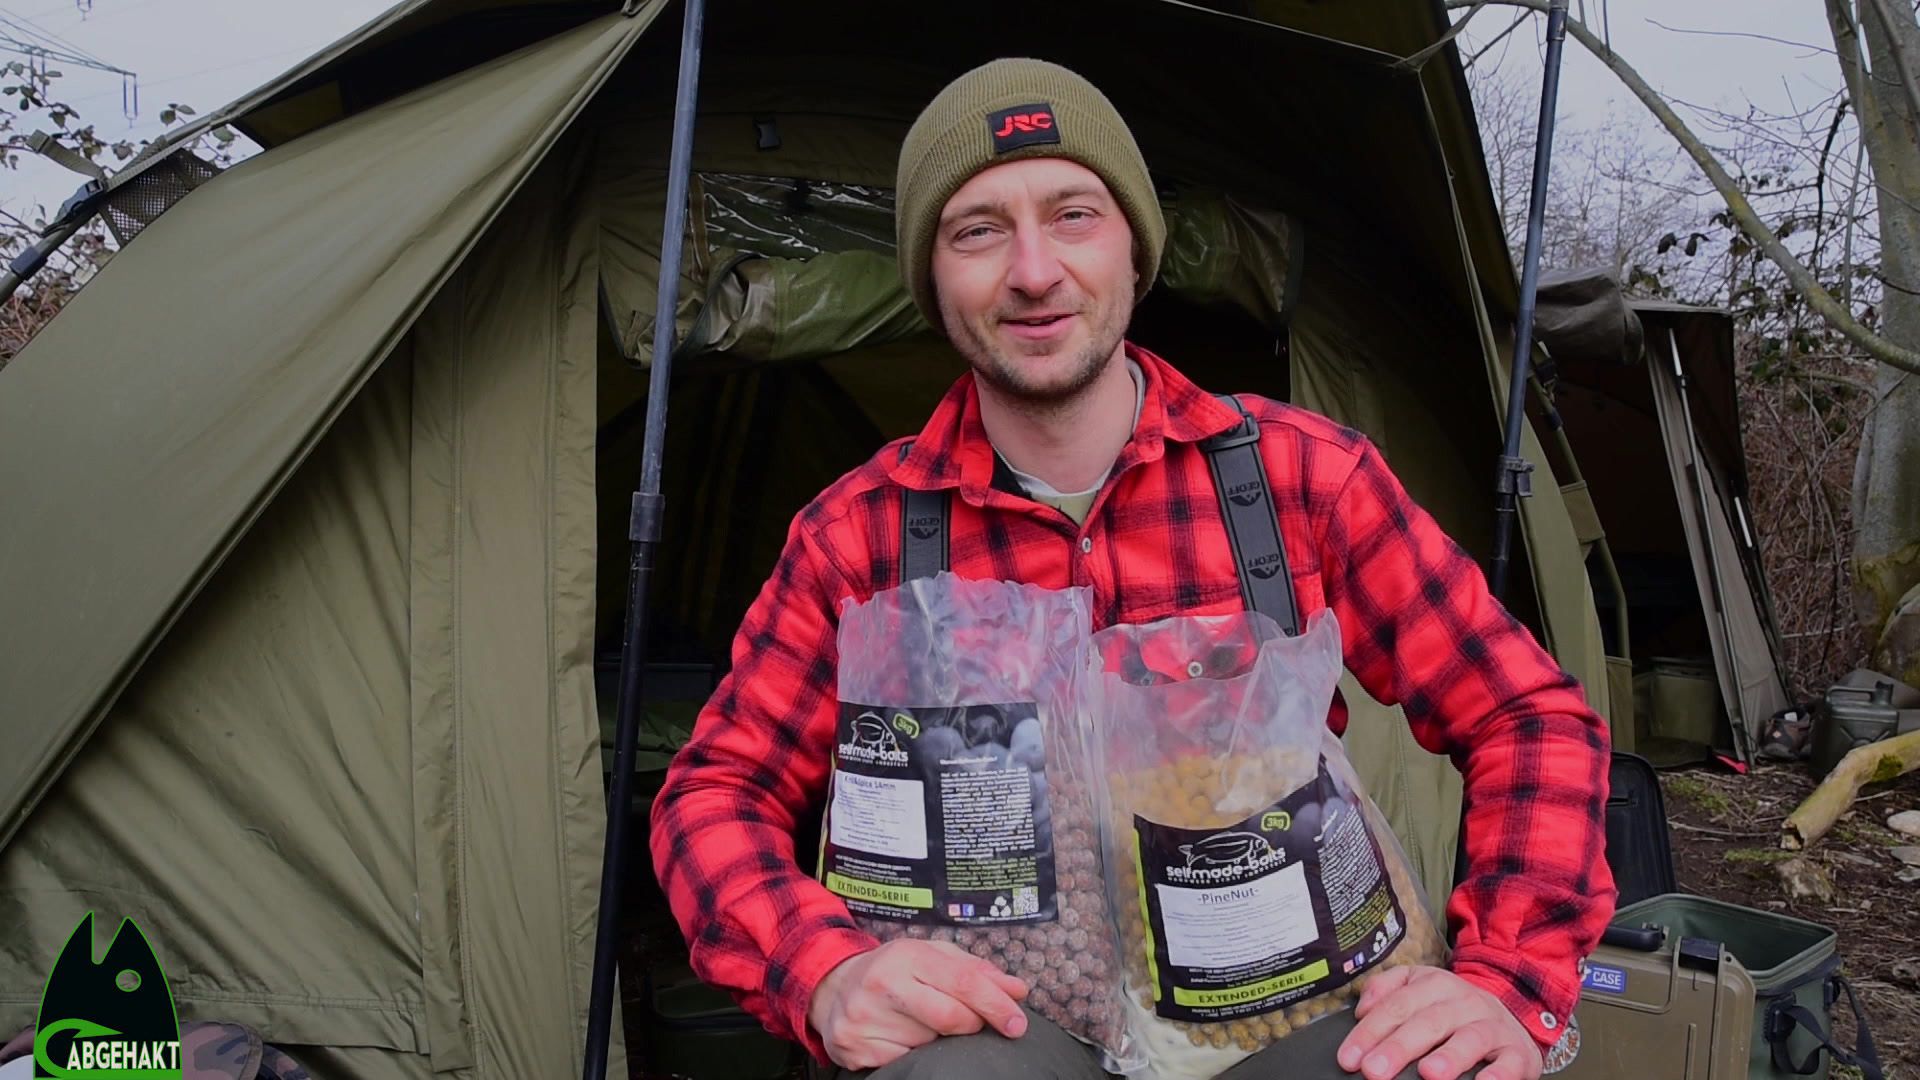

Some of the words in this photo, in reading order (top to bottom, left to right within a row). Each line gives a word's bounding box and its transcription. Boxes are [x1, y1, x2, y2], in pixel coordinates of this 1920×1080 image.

[995, 112, 1052, 137] JRC
[1227, 481, 1260, 496] GEOFF
[1248, 553, 1279, 568] GEOFF
[1166, 847, 1286, 880] selfmade-baits
[837, 880, 910, 902] EXTENDED-SERIE
[1198, 973, 1305, 1003] EXTENDED-SERIE
[1593, 971, 1622, 986] CASE
